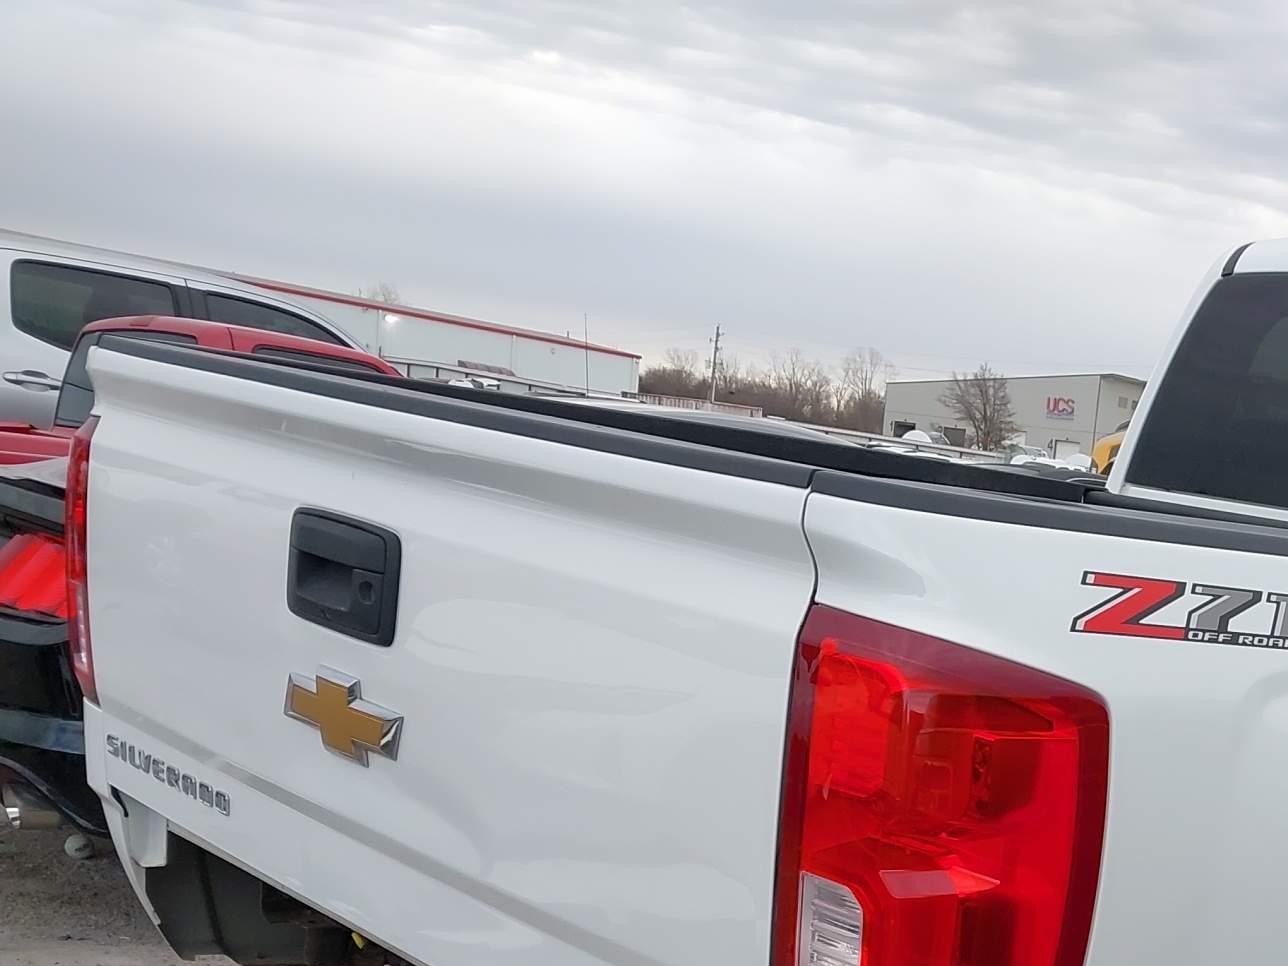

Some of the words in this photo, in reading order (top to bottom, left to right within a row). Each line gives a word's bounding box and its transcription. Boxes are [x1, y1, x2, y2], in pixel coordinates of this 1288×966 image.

[1046, 396, 1075, 416] UCS
[1187, 630, 1233, 644] OFF
[106, 734, 230, 817] SILVERADO
